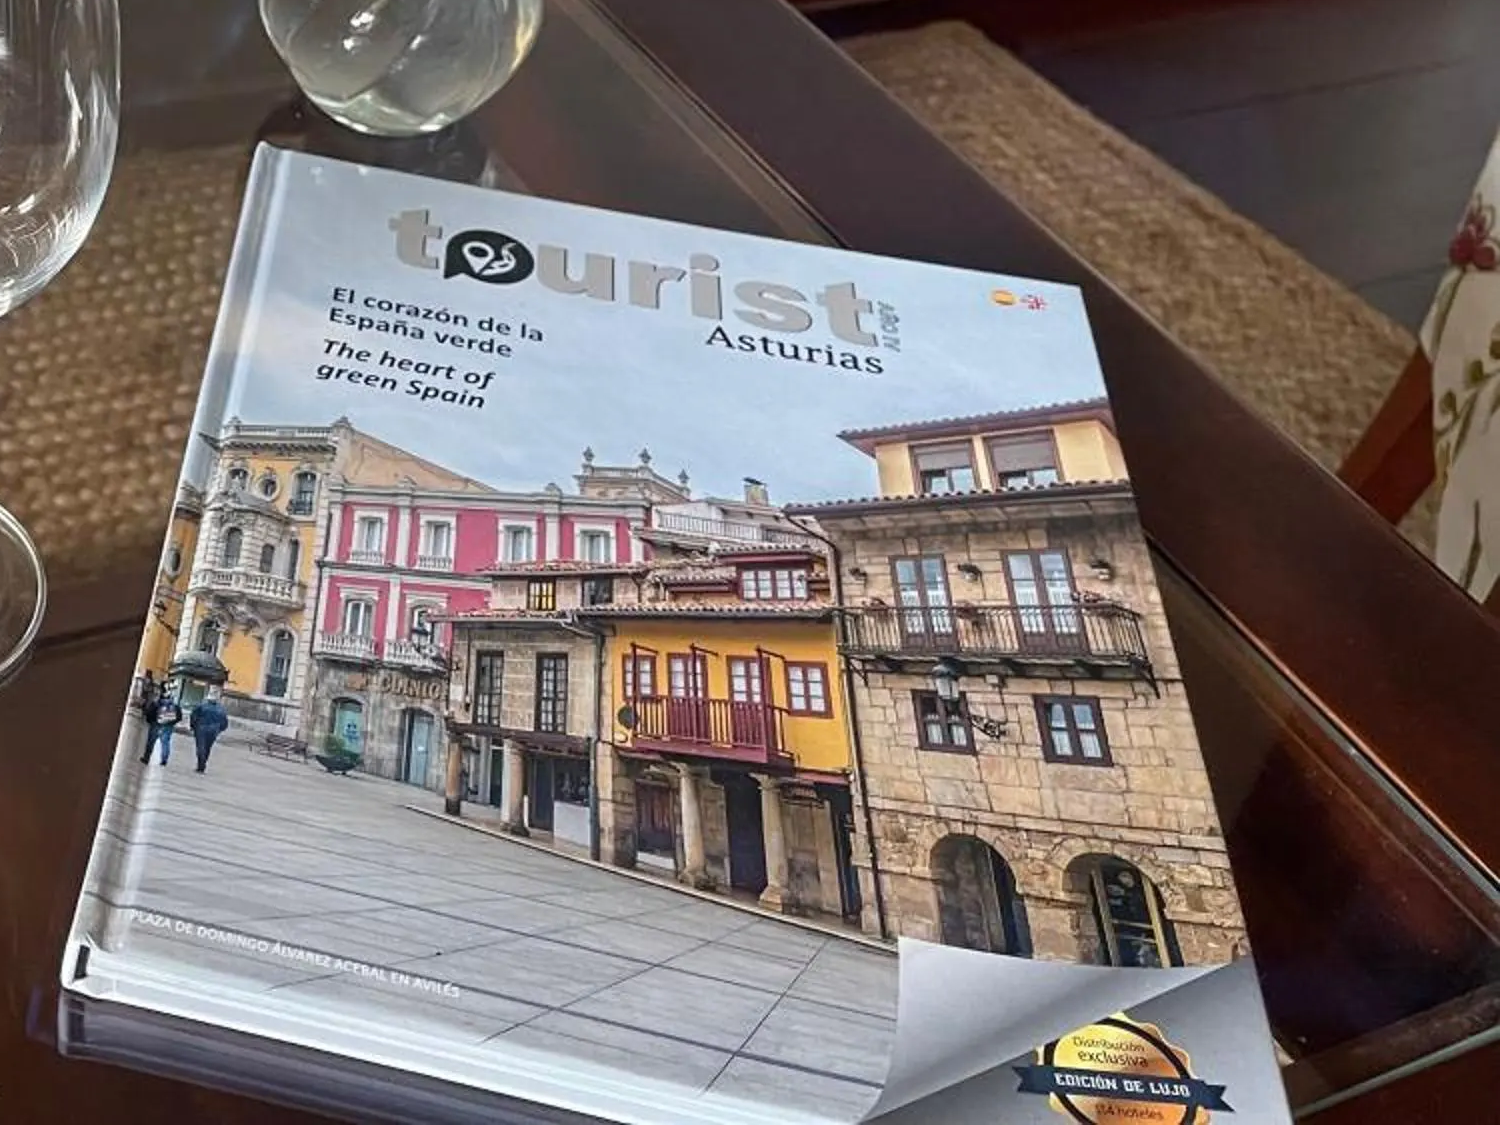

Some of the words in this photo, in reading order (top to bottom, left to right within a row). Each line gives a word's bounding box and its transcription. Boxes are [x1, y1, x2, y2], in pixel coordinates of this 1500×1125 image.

[329, 306, 425, 340] España
[434, 330, 513, 358] verde
[332, 286, 354, 304] El
[363, 295, 469, 327] corazón
[477, 316, 511, 335] de
[520, 322, 544, 342] la
[323, 338, 371, 363] The
[379, 350, 457, 380] heart
[464, 372, 496, 389] of
[705, 325, 885, 375] Asturias
[316, 364, 397, 391] green
[406, 380, 486, 409] Spain
[130, 908, 171, 930] PLAZA
[175, 920, 193, 935] DE
[197, 925, 269, 952] DOMINGO
[391, 971, 410, 986] EN
[1077, 1050, 1149, 1068] exclusiva
[1054, 1073, 1118, 1090] EDICIÓN
[1123, 1079, 1145, 1093] DE
[1149, 1082, 1191, 1098] LUJO
